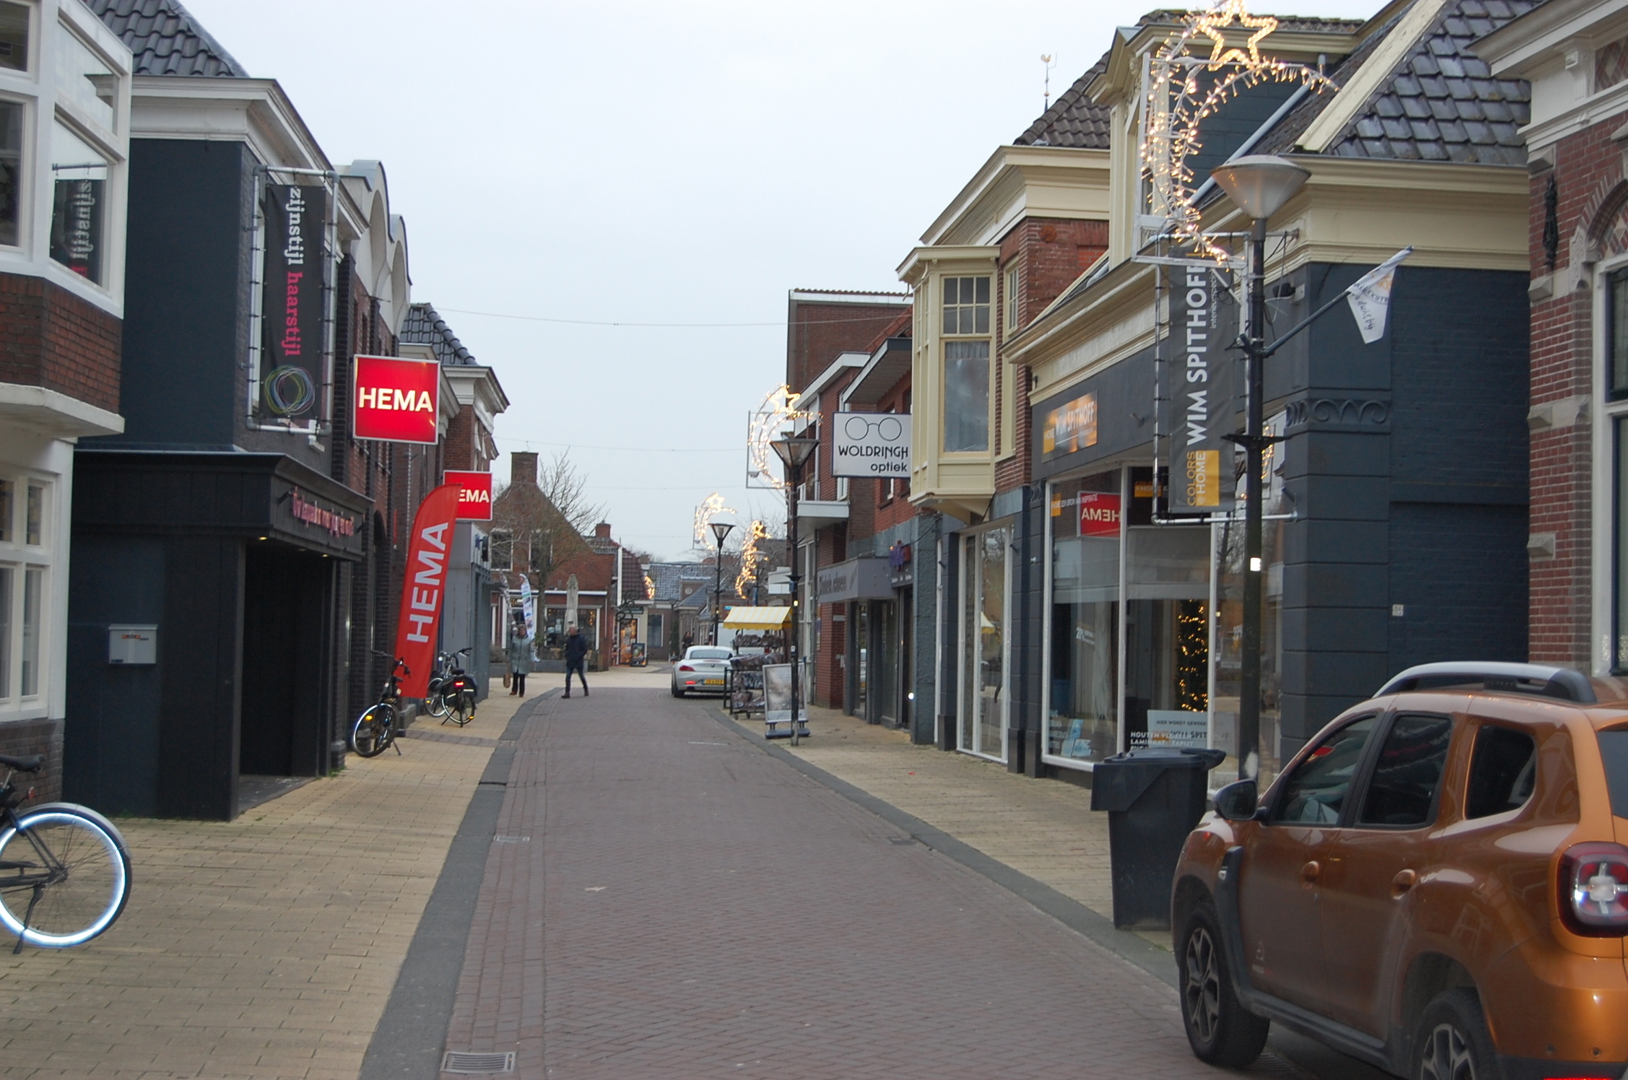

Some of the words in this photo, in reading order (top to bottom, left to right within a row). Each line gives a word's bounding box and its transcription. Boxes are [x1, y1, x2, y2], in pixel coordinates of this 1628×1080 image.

[284, 187, 306, 266] zijnstijl
[281, 272, 304, 357] haarstijl
[358, 387, 434, 412] HEMA
[1186, 390, 1208, 447] WIM
[838, 444, 909, 460] WOLDRINGH
[870, 462, 908, 474] optiek
[1186, 451, 1196, 507] COLORS
[458, 488, 490, 504] EMA
[406, 522, 449, 643] HEMA
